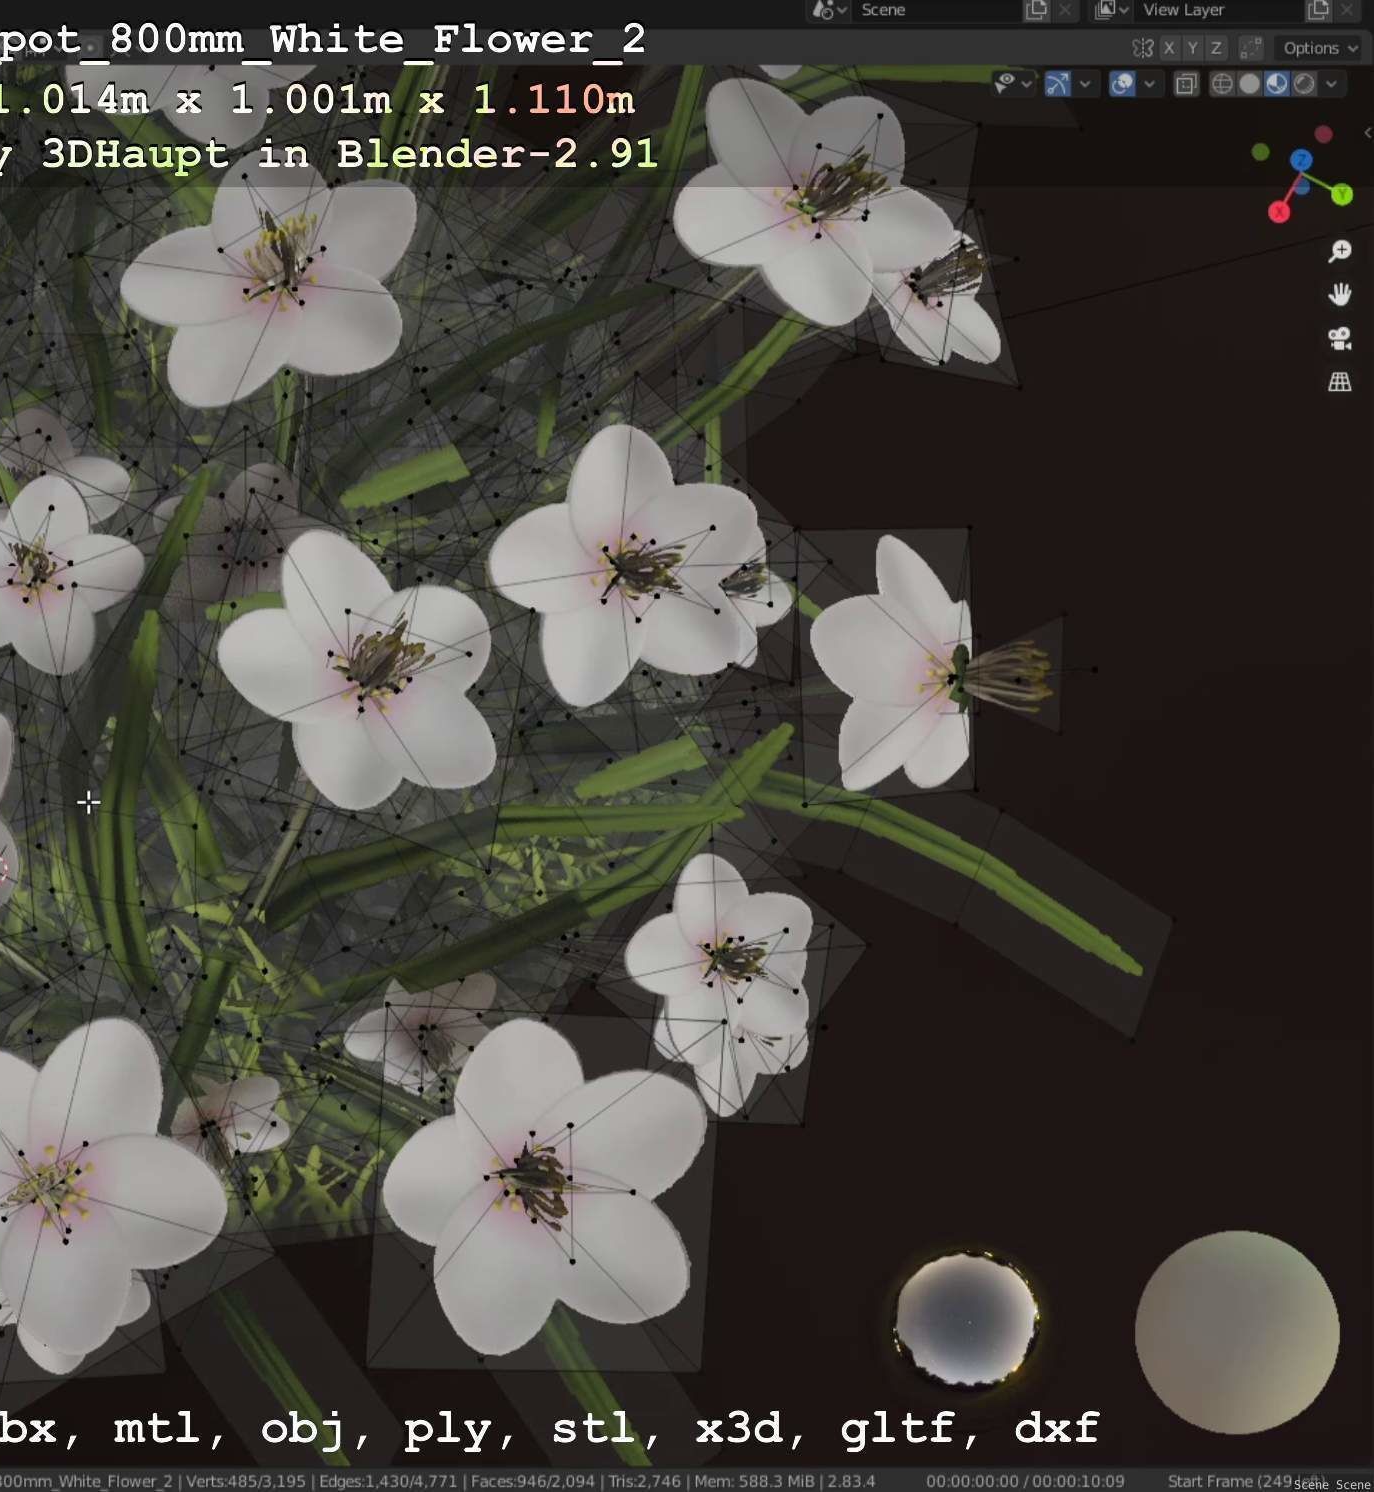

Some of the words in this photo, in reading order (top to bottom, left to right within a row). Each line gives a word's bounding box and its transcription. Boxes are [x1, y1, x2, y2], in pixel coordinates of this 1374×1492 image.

[862, 3, 906, 17] Scene
[1144, 3, 1178, 16] View
[1184, 3, 1224, 18] Layer
[1164, 42, 1175, 54] X
[1188, 42, 1198, 54] Y
[1211, 42, 1222, 54] Z
[1284, 42, 1340, 57] Options
[186, 1474, 306, 1490] Verts:485/3,195
[320, 1474, 457, 1491] Edges:1,430/4,771
[472, 1474, 595, 1490] Faces:946/2,094
[608, 1474, 681, 1490] Tris:2,746
[695, 1474, 734, 1489] Mem:
[739, 1474, 783, 1489] 588.3
[788, 1474, 816, 1489] MiB
[827, 1474, 876, 1489] 2.83.4
[926, 1474, 1019, 1489] 00:00:00:00
[1032, 1474, 1125, 1489] 00:00:10:09
[1169, 1474, 1203, 1488] Start
[1208, 1474, 1253, 1488] Frame
[1258, 1474, 1292, 1490] (249
